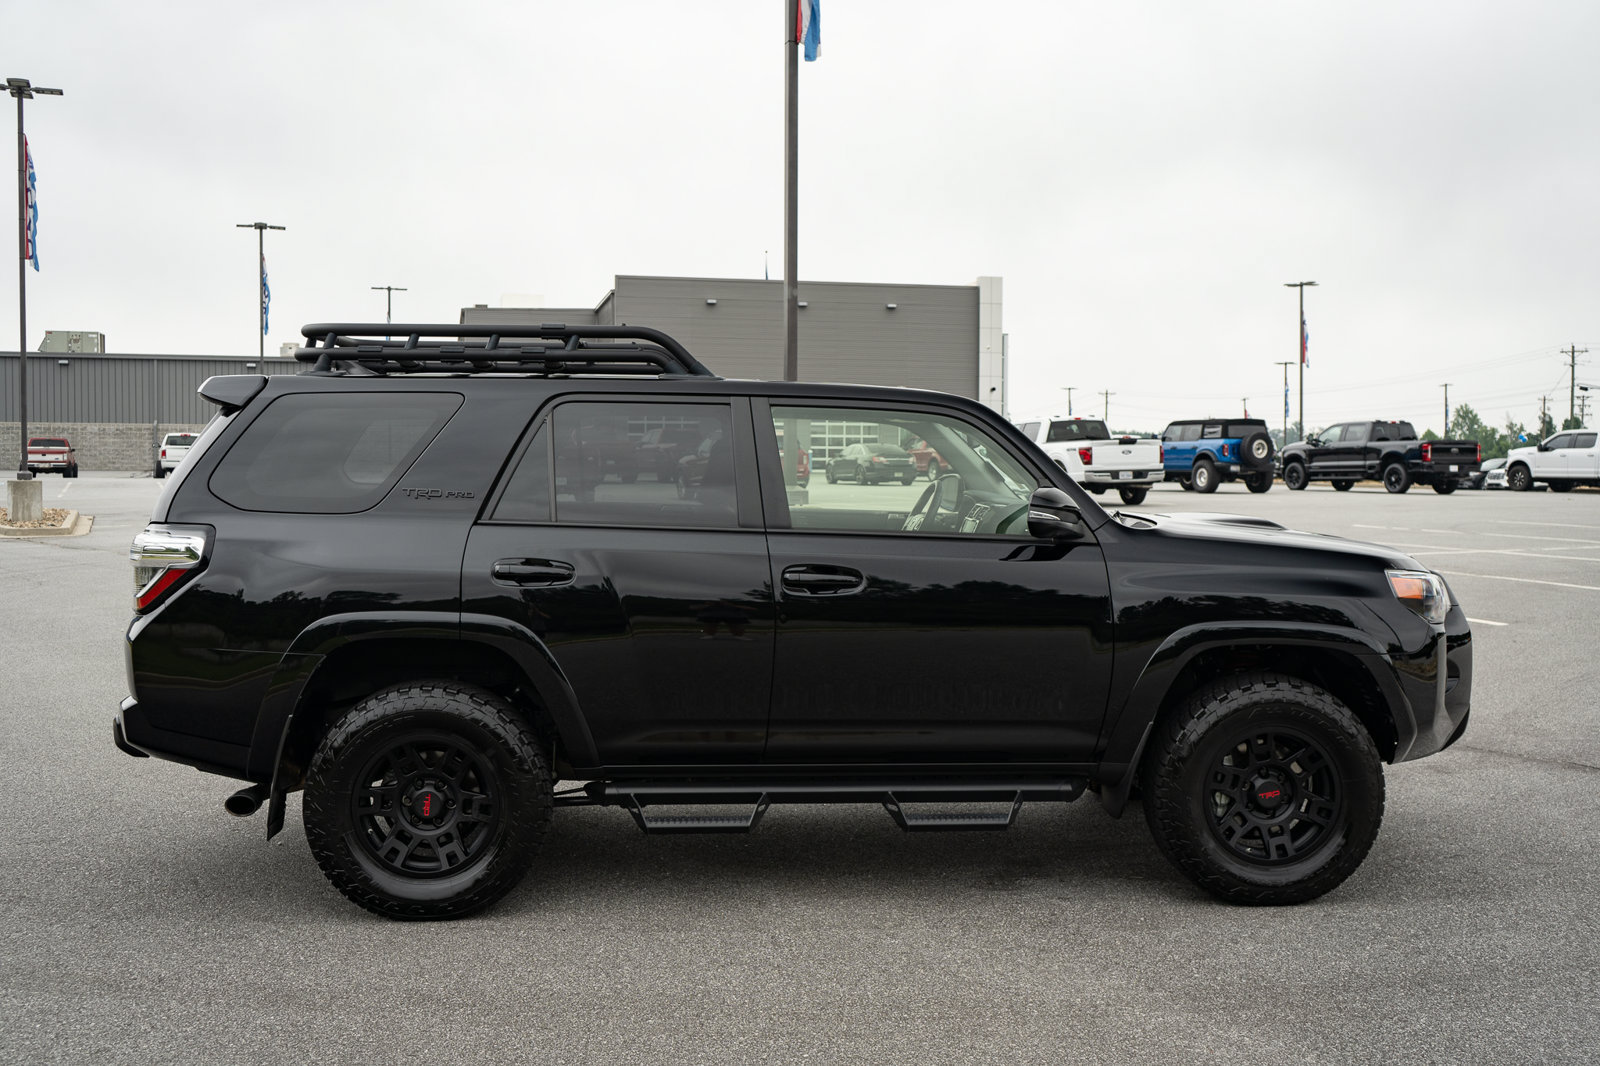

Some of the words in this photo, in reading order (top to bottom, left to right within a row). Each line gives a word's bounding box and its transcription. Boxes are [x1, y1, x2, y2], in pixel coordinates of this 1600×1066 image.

[402, 488, 442, 500] TRD
[446, 490, 475, 499] PRO
[1258, 790, 1280, 799] TRD
